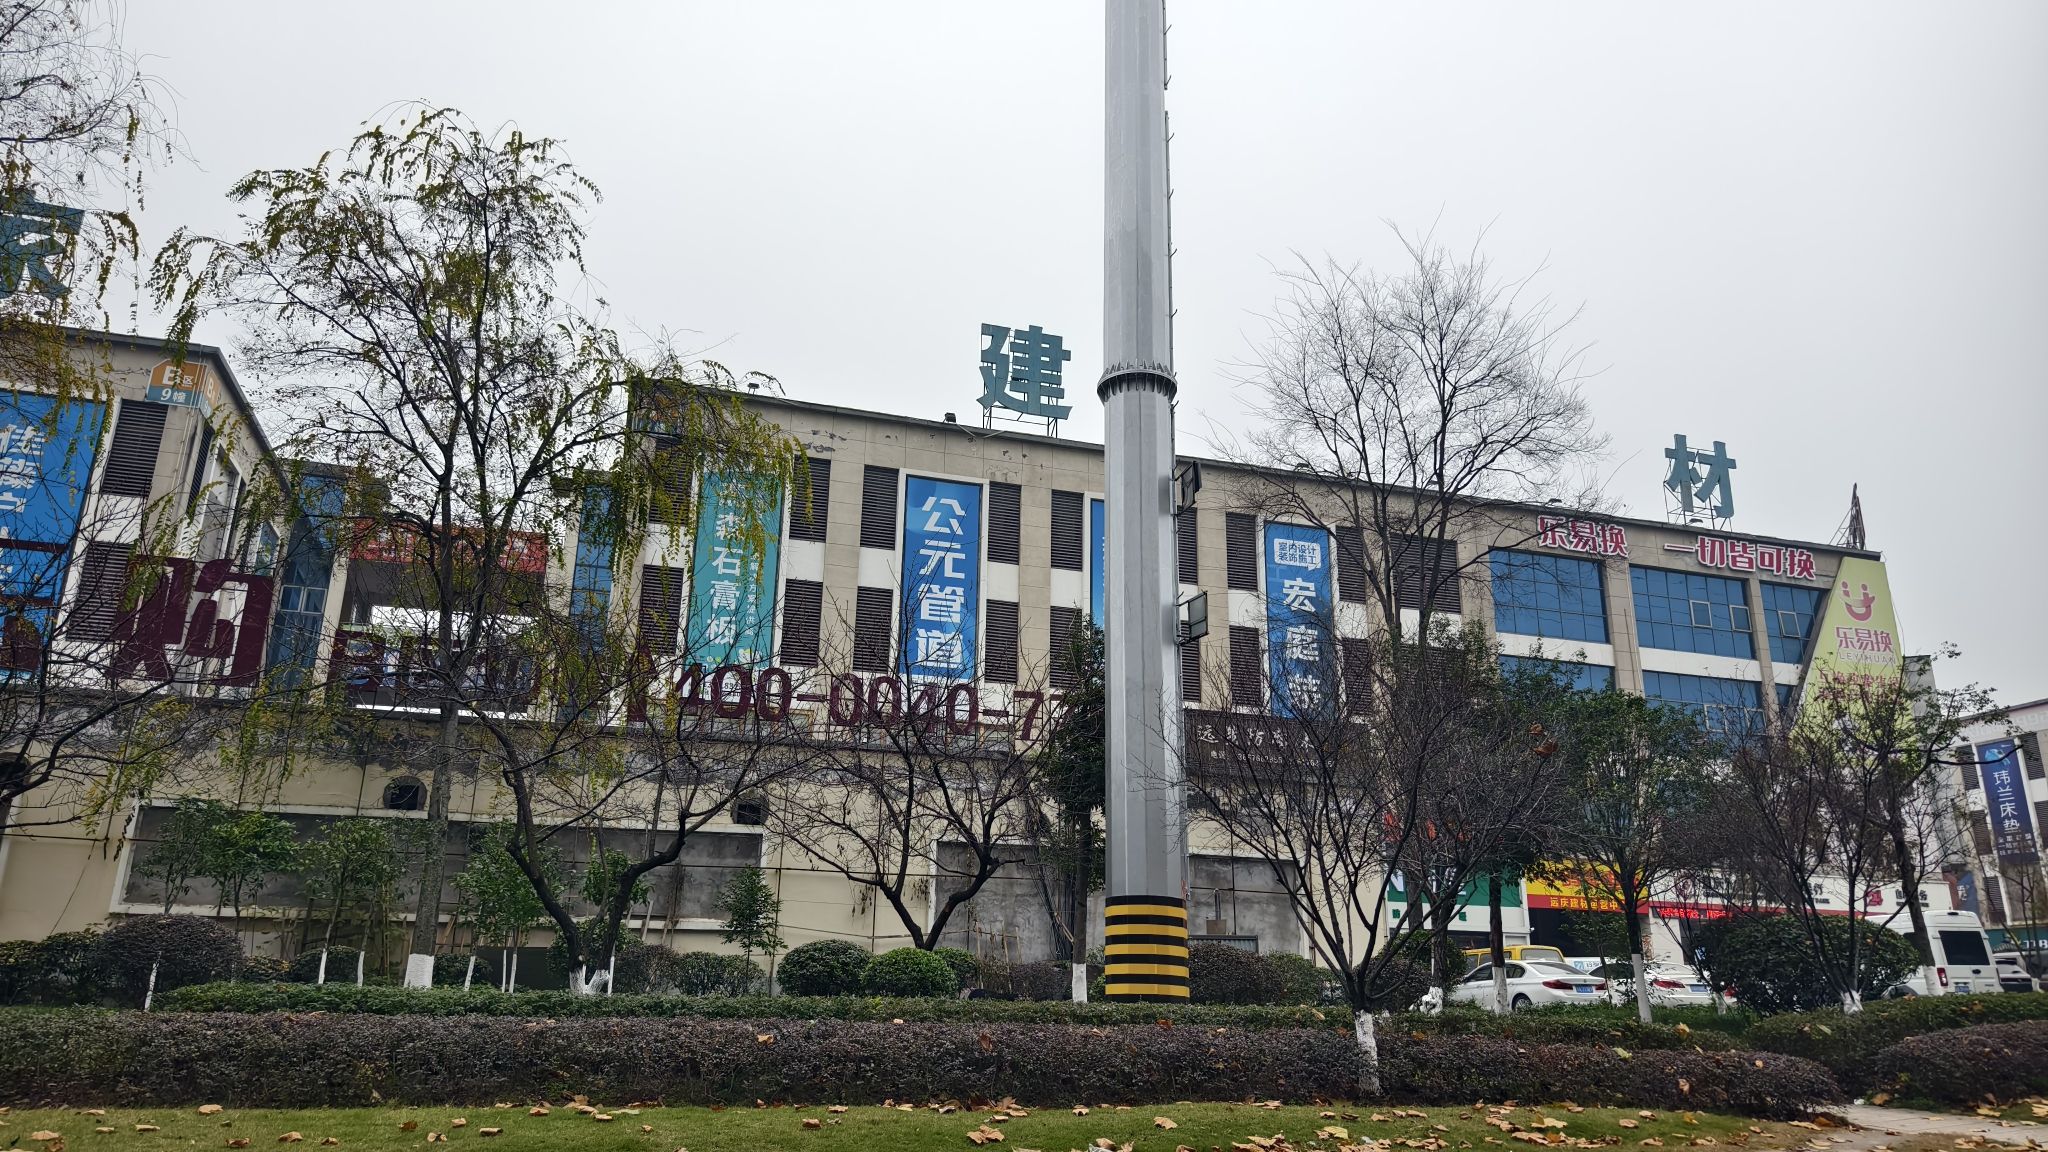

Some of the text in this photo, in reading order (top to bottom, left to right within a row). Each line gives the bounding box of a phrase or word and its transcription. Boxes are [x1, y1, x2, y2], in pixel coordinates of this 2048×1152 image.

[162, 366, 194, 388] B区
[976, 323, 1073, 420] 建
[1663, 433, 1737, 518] 材
[1278, 541, 1317, 555] 室内设计
[1537, 515, 1629, 557] 乐易换
[1278, 551, 1317, 564] 装饰施工
[1664, 535, 1816, 581] 一切皆可换
[914, 496, 966, 670] 公元管道
[1835, 626, 1895, 653] 乐易换
